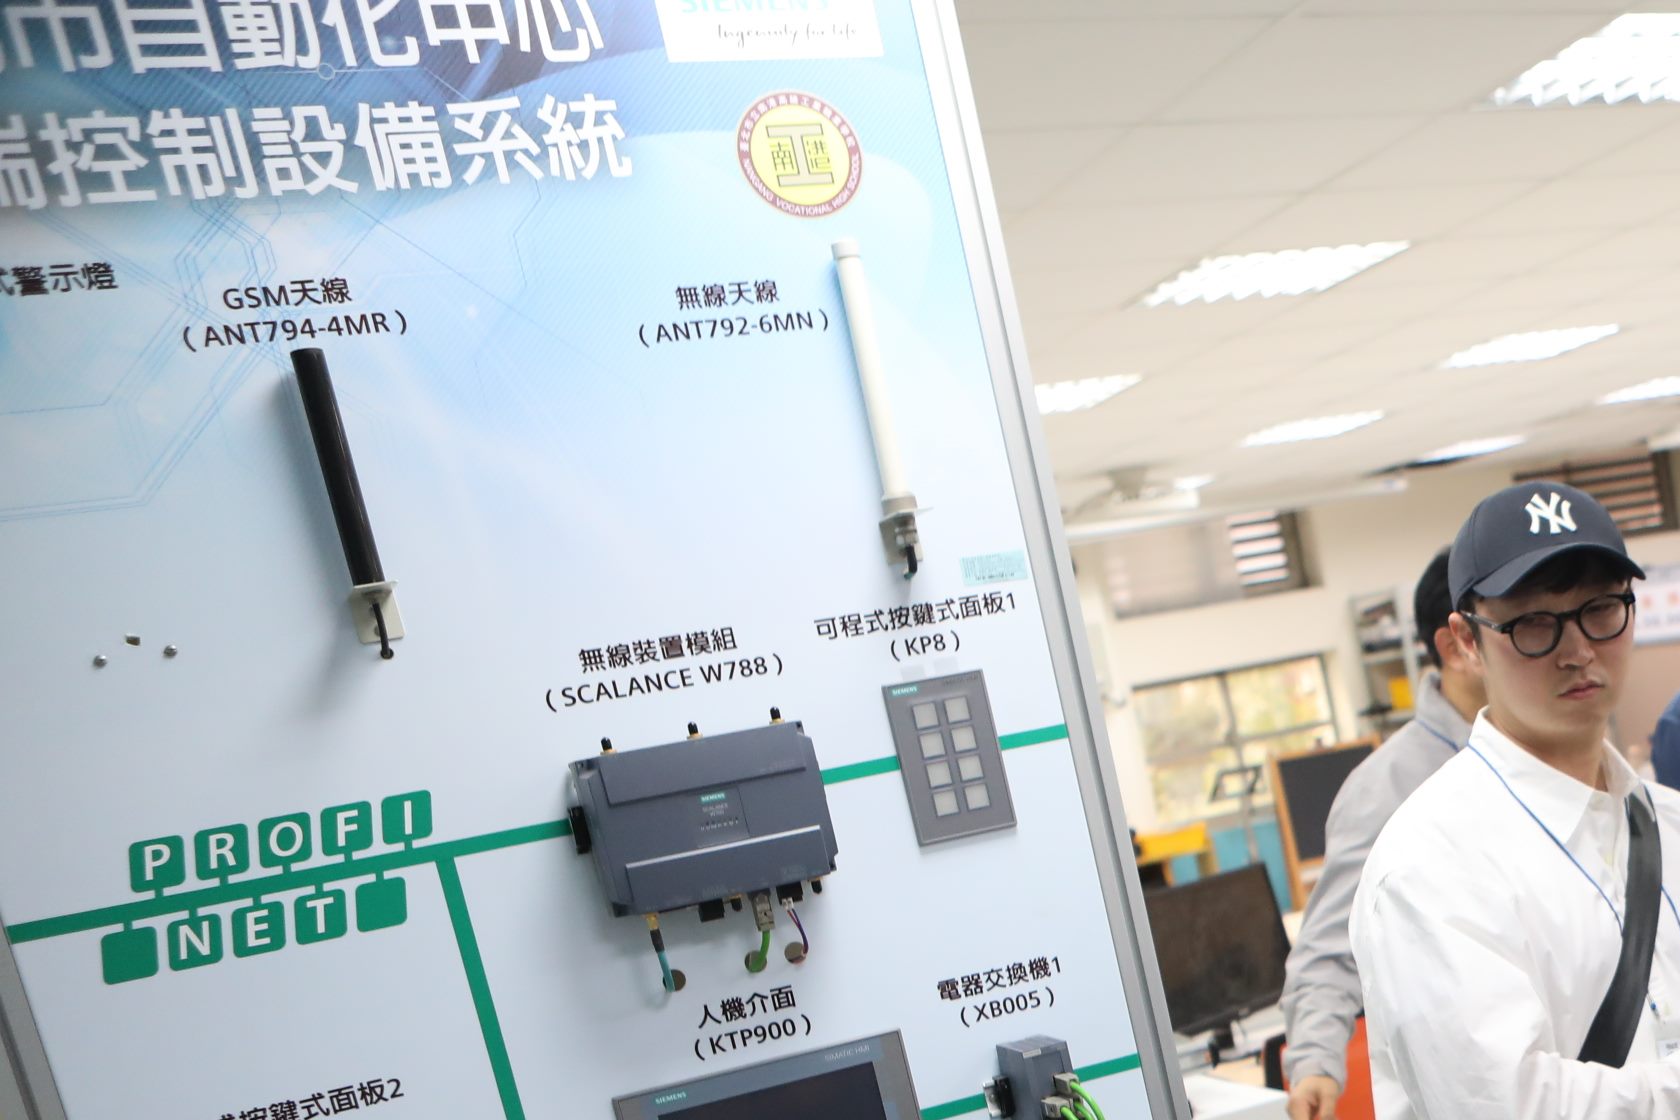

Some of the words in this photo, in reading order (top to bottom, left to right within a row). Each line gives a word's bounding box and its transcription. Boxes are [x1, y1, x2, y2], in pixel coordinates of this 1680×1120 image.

[0, 0, 605, 73] 市自動化中心
[222, 277, 352, 310] GSM天線
[675, 279, 780, 309] 無線天線
[183, 309, 408, 352] (ANT794-4MR)
[638, 309, 830, 347] (ANT792-6MN)
[1524, 491, 1578, 535] NY
[814, 591, 1017, 640] 可程式按鍵式面板1
[579, 627, 738, 674] 無線裝置模組
[890, 630, 961, 661] (KP8)
[545, 669, 693, 713] (SCALANCE
[700, 653, 784, 691] W788)
[143, 799, 414, 882] PROFI
[178, 896, 335, 961] NET
[936, 956, 1063, 1004] 電器交換機1
[698, 985, 797, 1029] 人機介面
[959, 986, 1056, 1029] (XB005)
[693, 1013, 814, 1062] (KTP900)
